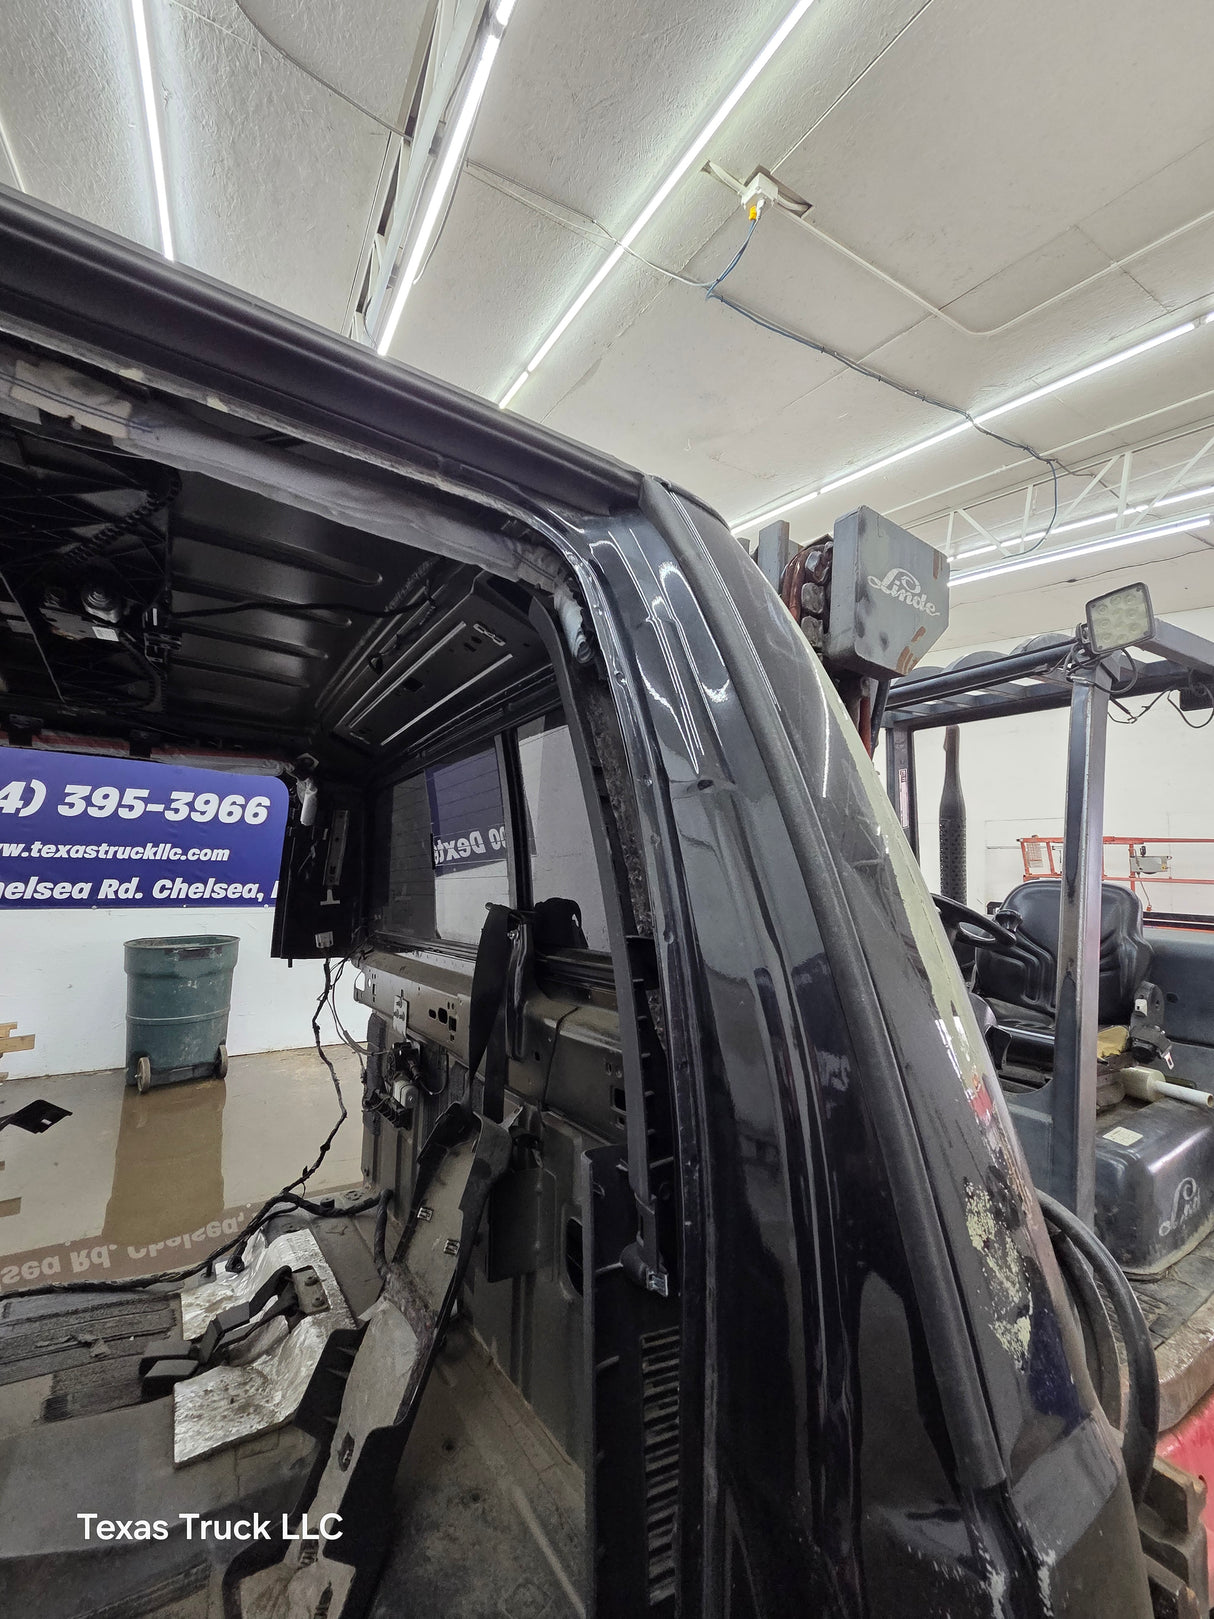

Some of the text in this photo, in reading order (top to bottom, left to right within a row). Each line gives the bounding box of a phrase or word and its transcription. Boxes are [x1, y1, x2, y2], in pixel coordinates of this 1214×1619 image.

[867, 567, 941, 617] Linde
[57, 784, 271, 825] 395-3966
[0, 841, 230, 862] w.texastruckllc.com
[0, 876, 93, 900] elsea
[97, 876, 144, 900] Rd.
[152, 877, 265, 902] Chelsea,
